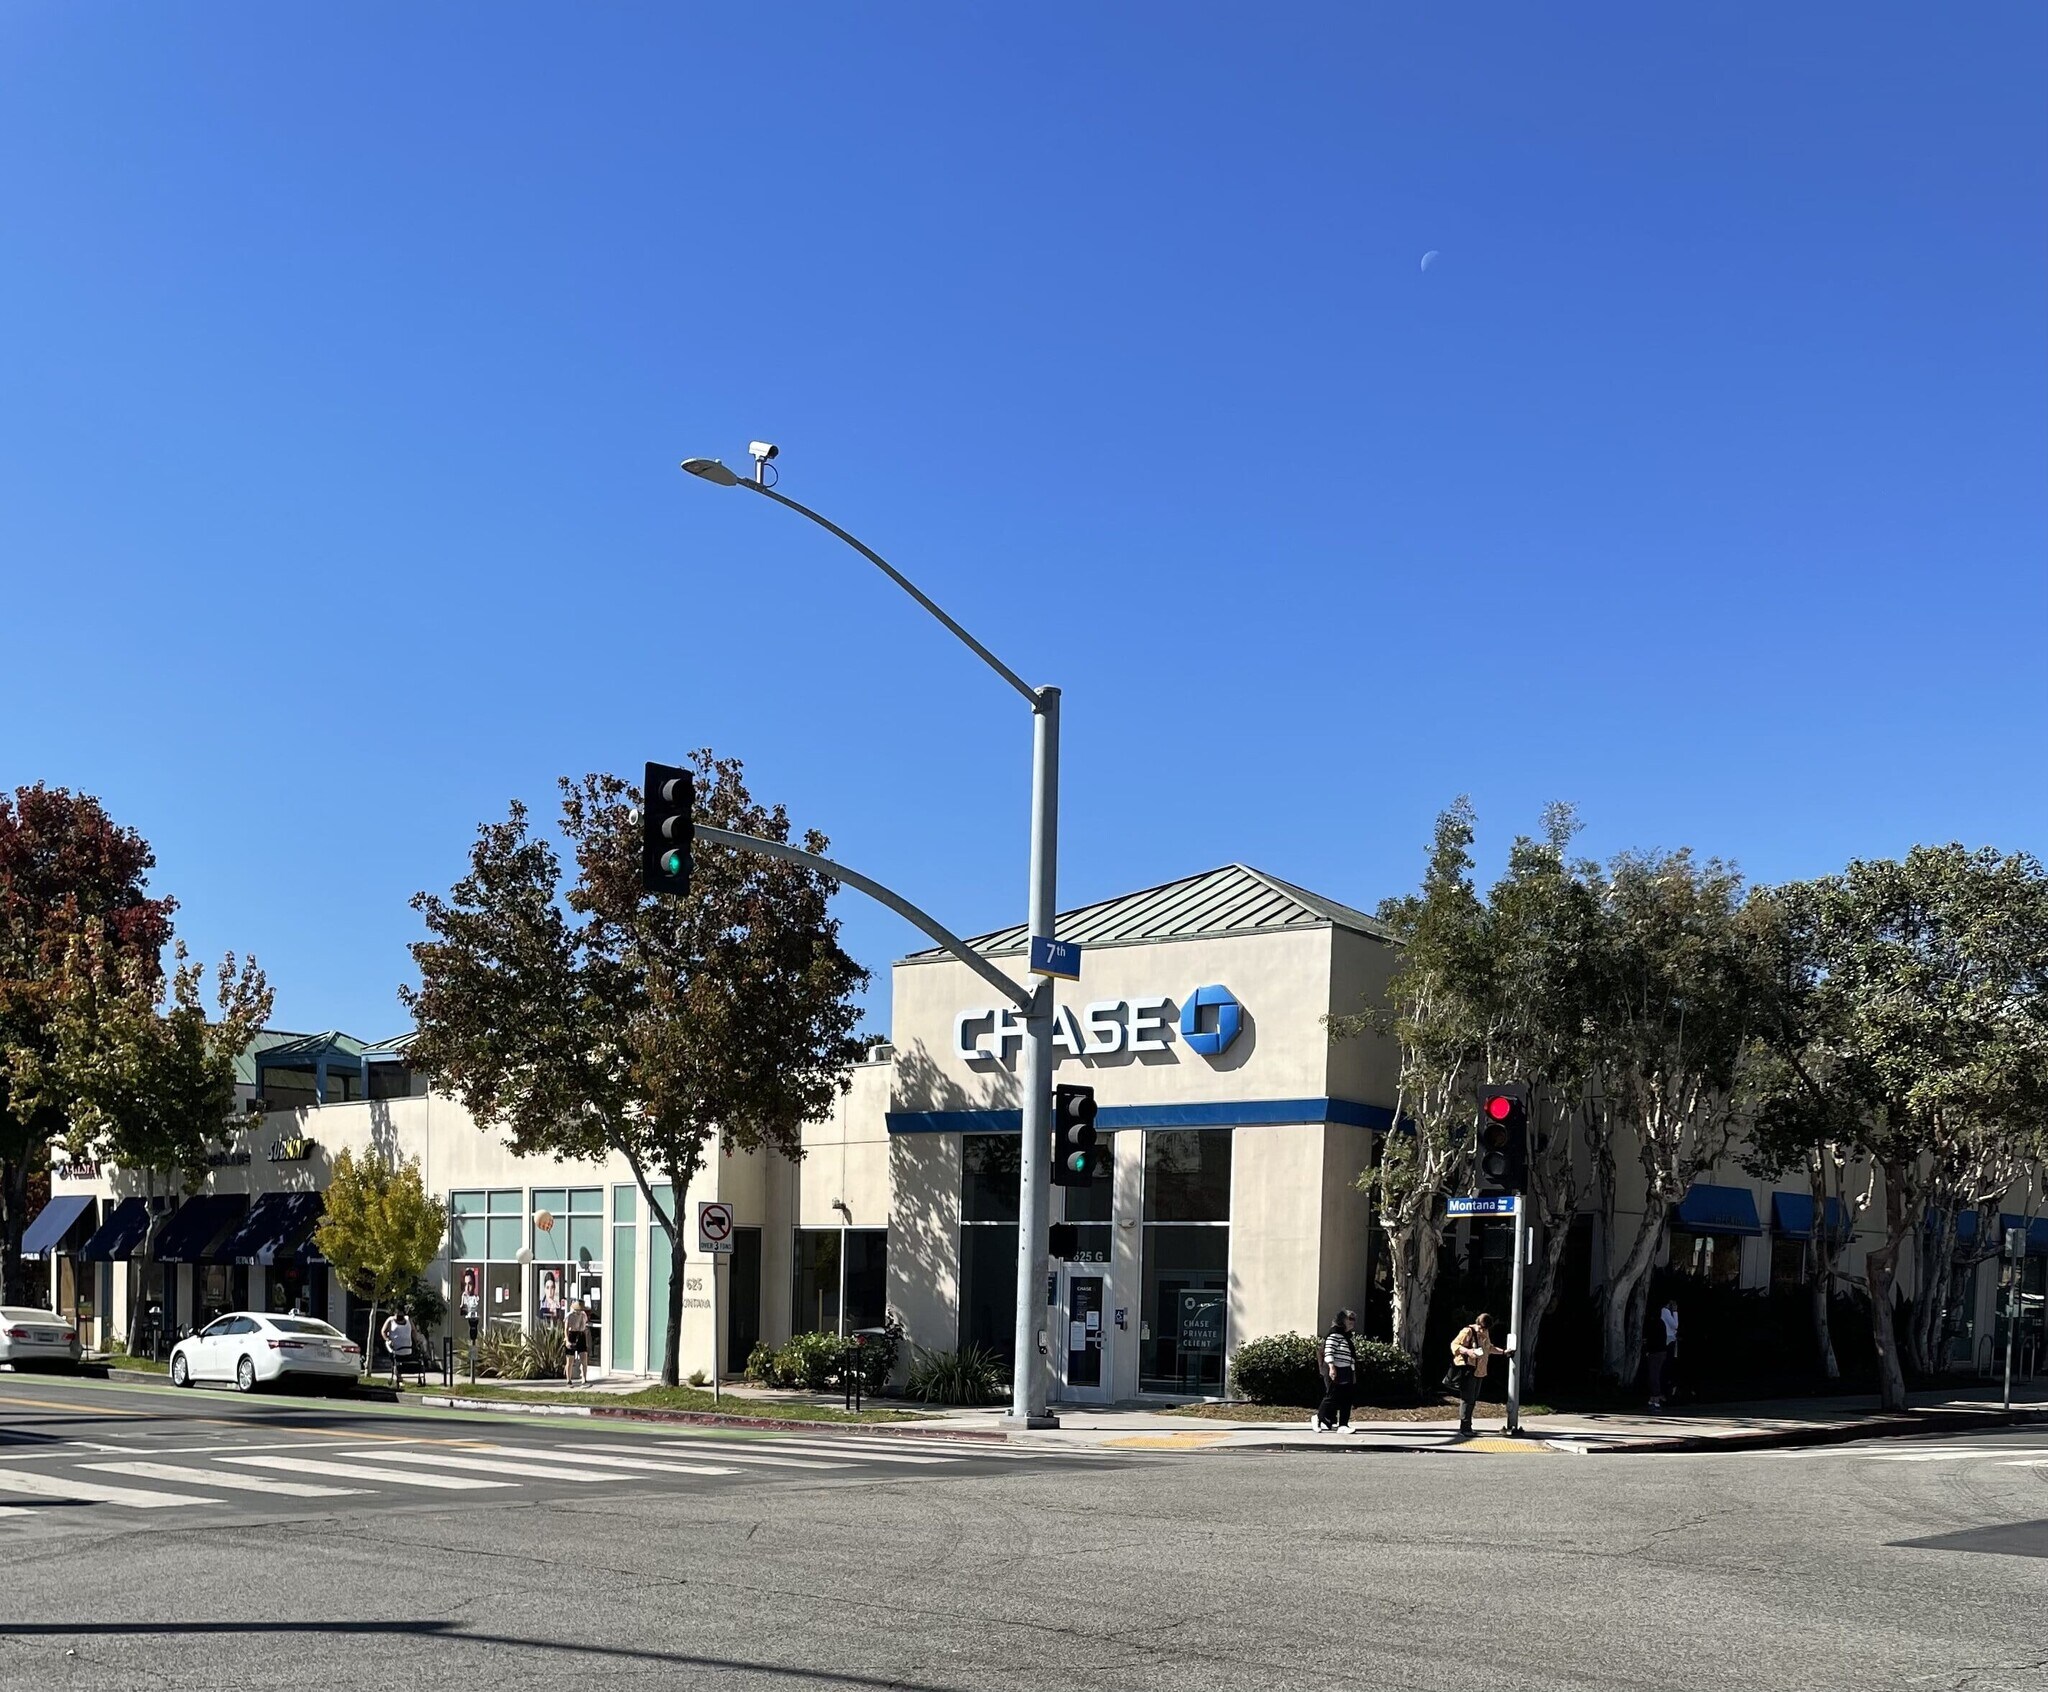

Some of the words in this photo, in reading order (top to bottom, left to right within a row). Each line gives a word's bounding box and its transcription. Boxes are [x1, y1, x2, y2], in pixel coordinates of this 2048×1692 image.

[1046, 943, 1066, 964] 7th
[953, 997, 1171, 1060] CHASE
[267, 1138, 314, 1162] SUBWAY
[1449, 1200, 1496, 1211] Montana
[714, 1241, 719, 1251] 3
[1095, 1251, 1104, 1262] G
[686, 1279, 703, 1291] 625
[683, 1298, 711, 1309] ONTANA
[1183, 1320, 1209, 1328] CHASE
[1183, 1330, 1217, 1338] PRIVATE
[1183, 1339, 1211, 1347] CLIENT
